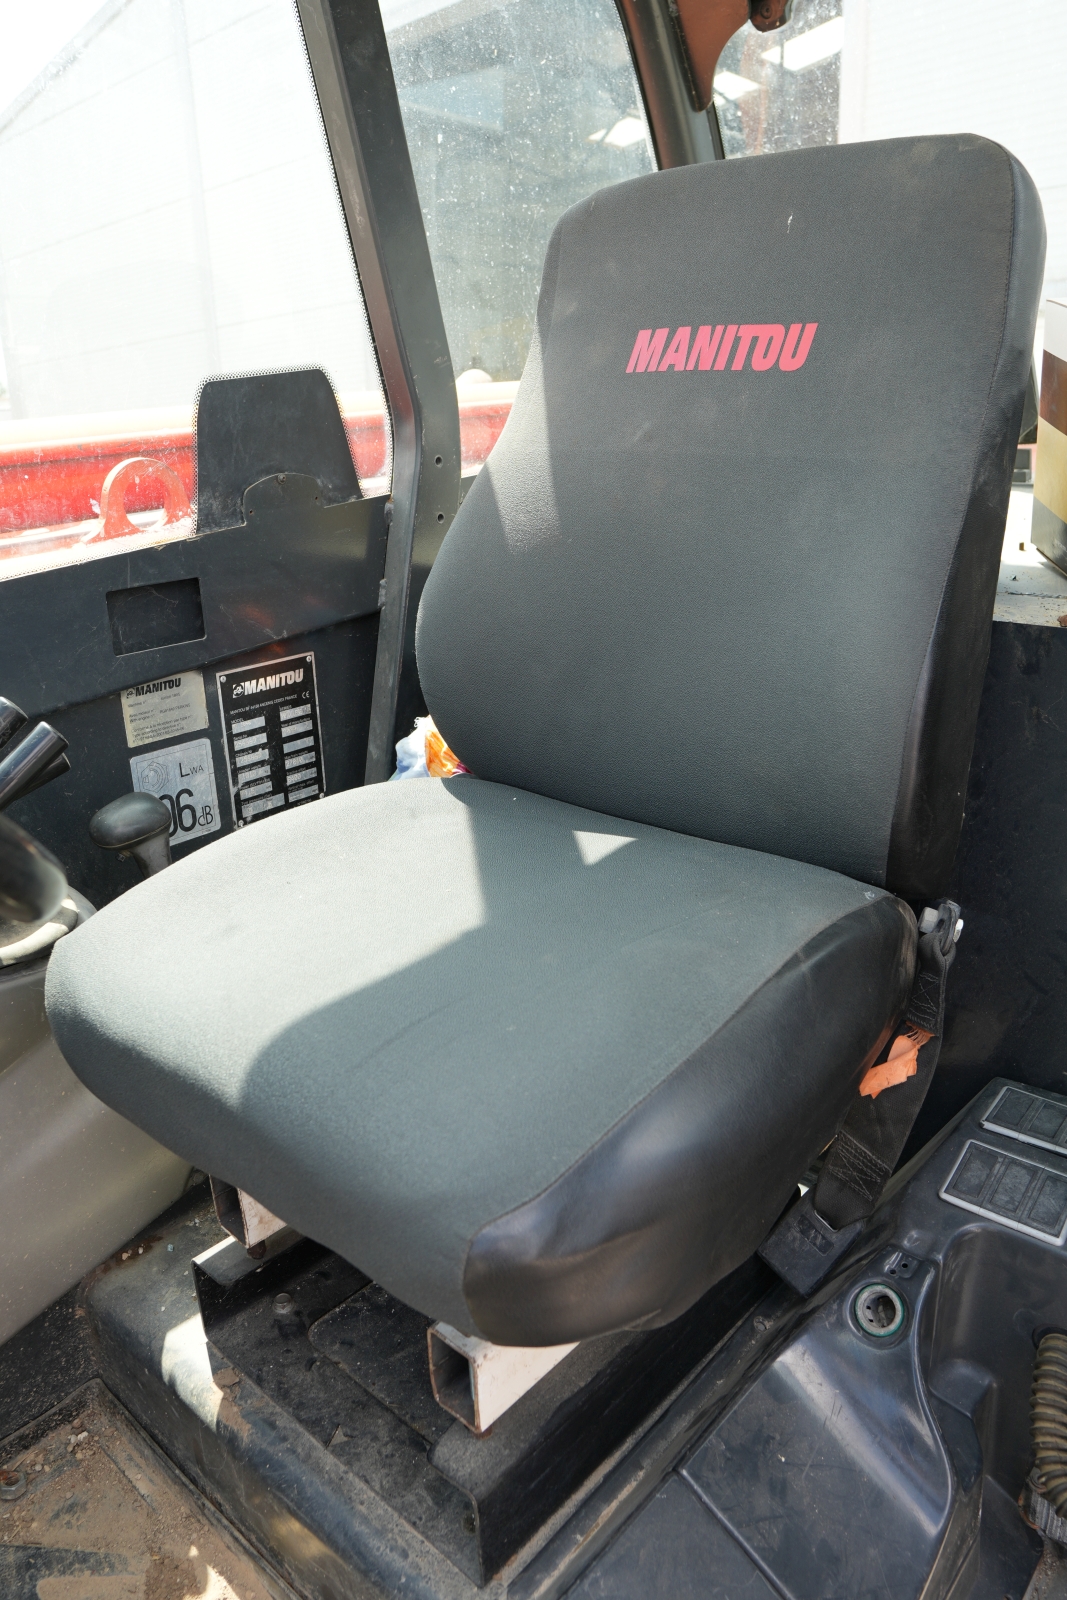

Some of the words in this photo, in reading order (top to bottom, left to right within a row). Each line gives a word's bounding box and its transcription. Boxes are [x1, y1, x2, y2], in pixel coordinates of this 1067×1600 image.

[625, 322, 819, 374] MANITOU
[135, 678, 181, 697] MANITOU
[244, 668, 304, 696] MANITOU
[197, 805, 214, 827] dB
